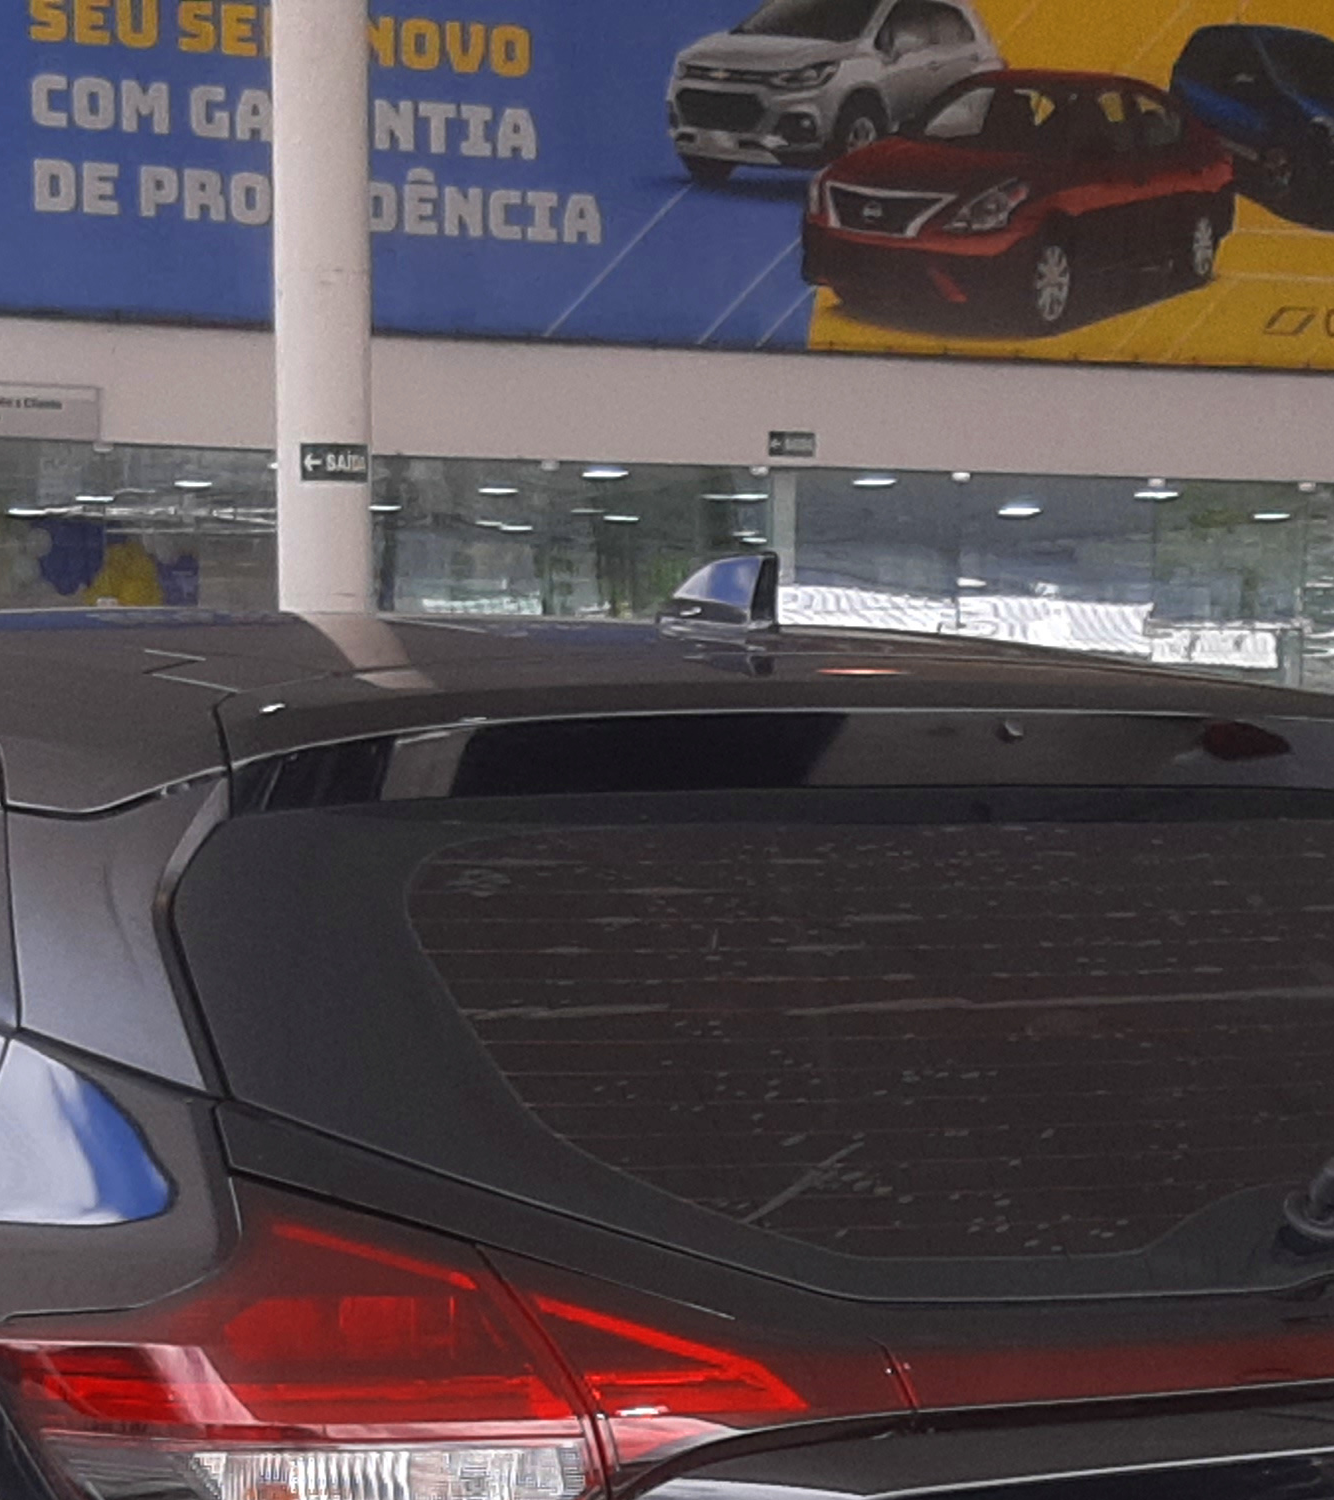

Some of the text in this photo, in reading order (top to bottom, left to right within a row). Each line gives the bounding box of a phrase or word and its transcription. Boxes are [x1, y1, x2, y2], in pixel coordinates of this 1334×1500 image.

[28, 0, 532, 77] SEU SENOVO
[30, 74, 537, 160] COM GANTIA
[33, 158, 602, 244] DE PRODÊNCIA
